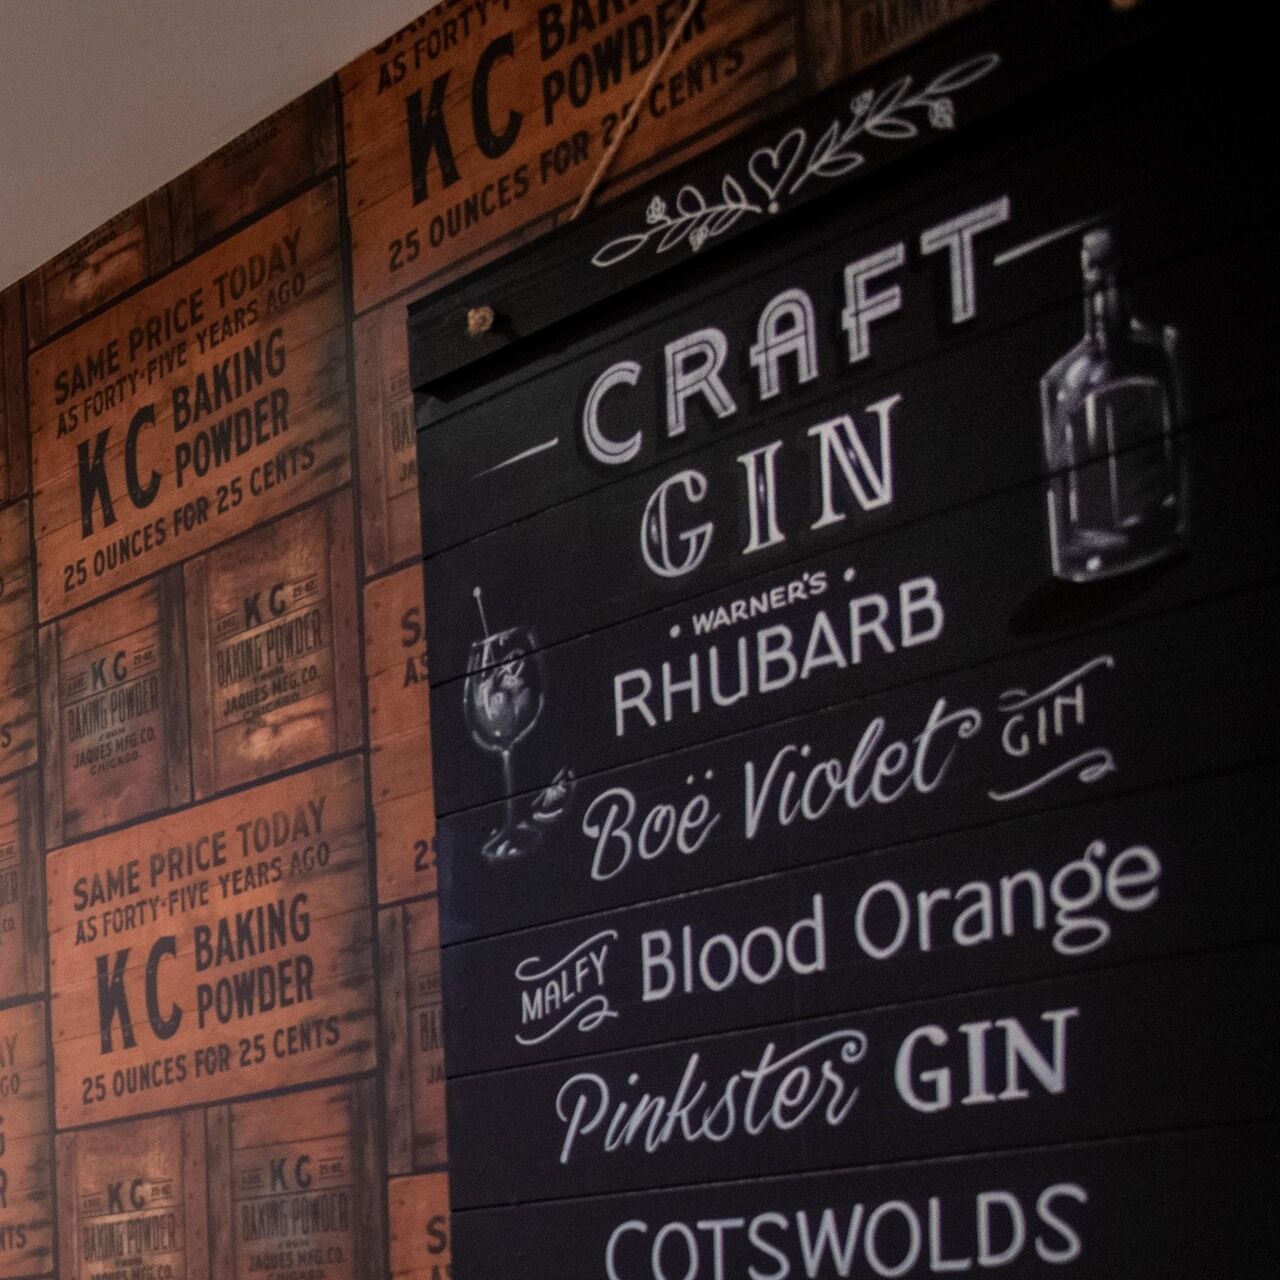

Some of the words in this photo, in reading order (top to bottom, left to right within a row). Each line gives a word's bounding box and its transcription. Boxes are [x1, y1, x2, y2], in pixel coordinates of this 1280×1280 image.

[53, 344, 119, 406] SAME
[128, 288, 205, 359] PRICE
[213, 226, 303, 304] TODAY
[56, 404, 79, 440] AS
[195, 305, 259, 356] YEARS
[266, 271, 307, 320] AGO
[172, 327, 287, 433] BAKING
[581, 195, 1010, 466] CRAFT
[175, 387, 290, 489] POWDER
[640, 394, 904, 578] GIN
[63, 562, 88, 593] 25
[93, 526, 168, 580] OUNCES
[173, 497, 211, 538] FOR
[216, 481, 243, 515] 25
[249, 440, 317, 498] CENTS
[613, 576, 945, 737] RHUBARB
[692, 571, 828, 636] WARNER'S
[583, 768, 723, 881] Boë
[743, 697, 982, 840] Violet
[1001, 684, 1086, 758] GIN
[72, 859, 141, 912] SAME
[149, 829, 227, 889] PRICE
[237, 797, 327, 859] TODAY
[74, 919, 98, 946] AS
[217, 855, 282, 900] YEARS
[289, 841, 331, 875] AGO
[640, 892, 827, 1003] Blood
[854, 839, 1162, 957] Orange
[193, 892, 311, 973] BAKING
[196, 953, 315, 1030] POWDER
[519, 942, 609, 1026] MALFY
[82, 1075, 107, 1105] 25
[112, 1054, 188, 1098] OUNCES
[194, 1042, 230, 1075] FOR
[239, 1036, 266, 1068] 25
[273, 1014, 341, 1059] CENTS
[555, 1030, 869, 1165] Pinkster
[894, 1007, 1082, 1114] GIN
